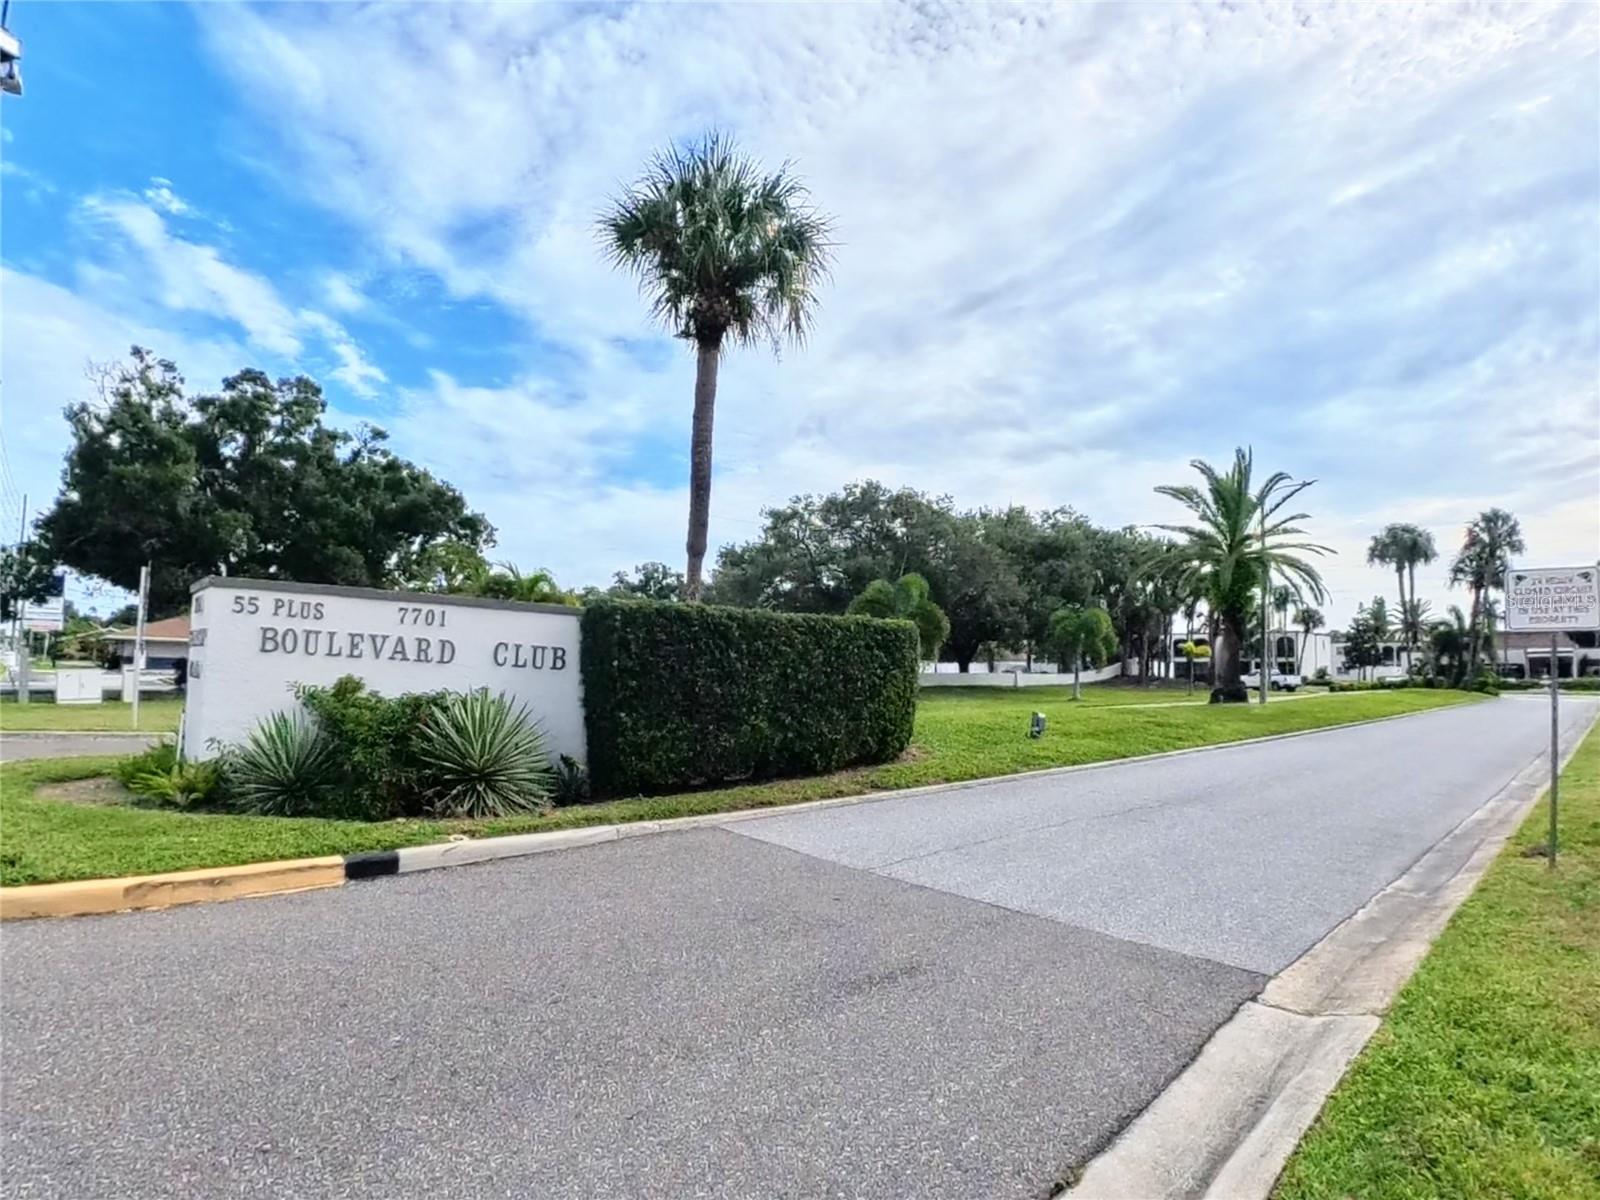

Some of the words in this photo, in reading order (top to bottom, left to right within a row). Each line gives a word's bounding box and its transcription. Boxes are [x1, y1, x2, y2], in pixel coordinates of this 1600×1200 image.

[231, 595, 260, 615] 55
[272, 598, 325, 620] PLUS
[398, 607, 446, 627] 7701
[259, 626, 456, 665] BOULEVARD
[493, 641, 566, 671] CLUB
